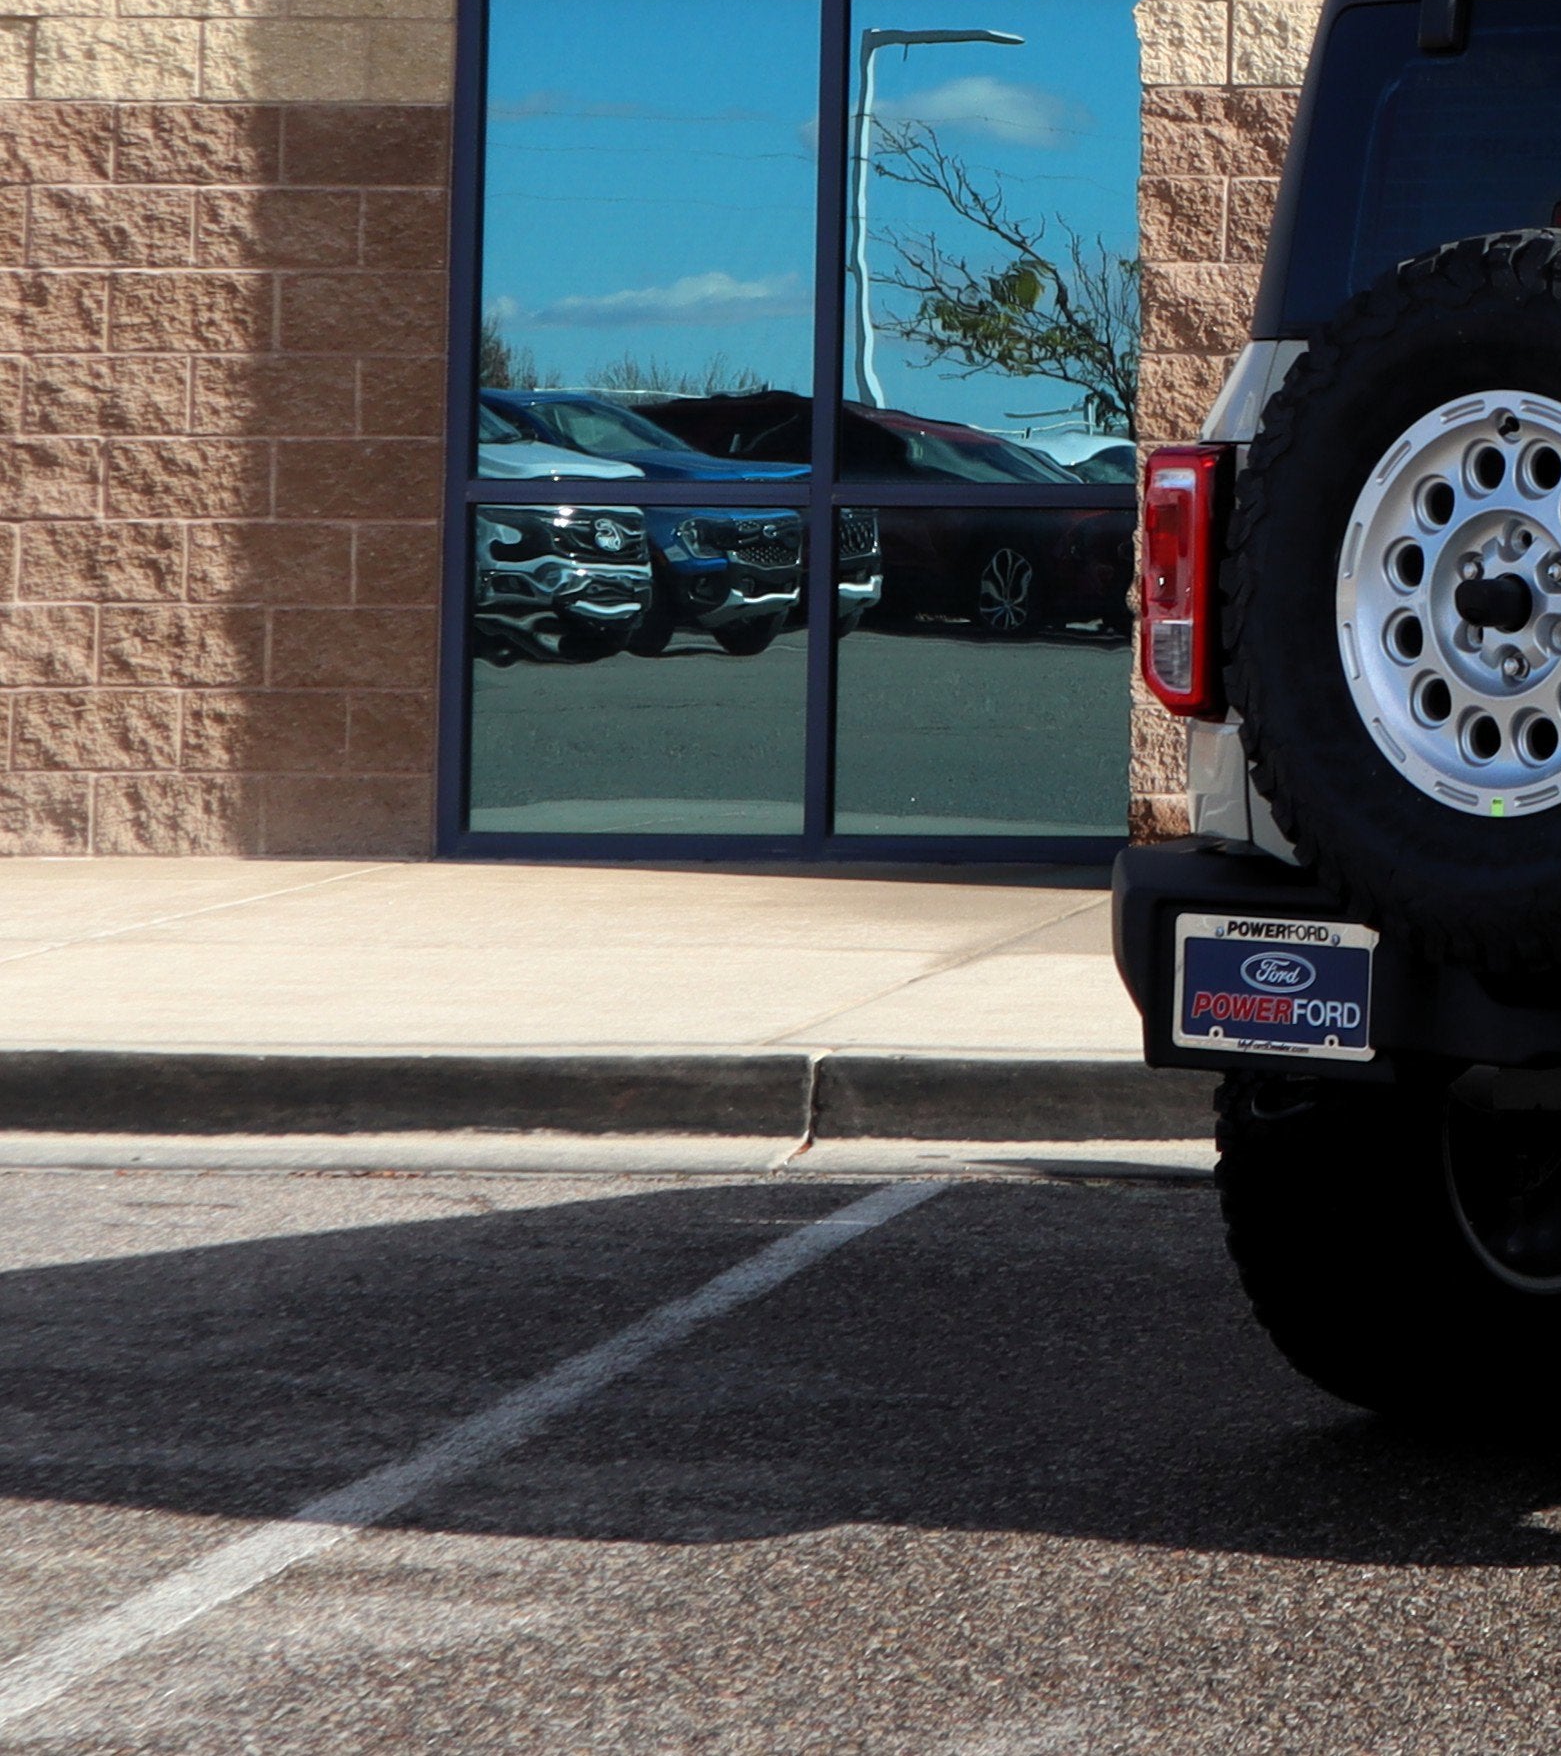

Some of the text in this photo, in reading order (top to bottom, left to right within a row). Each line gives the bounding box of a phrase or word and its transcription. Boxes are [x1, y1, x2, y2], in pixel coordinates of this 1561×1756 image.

[1227, 921, 1329, 941] POWERFORD
[1255, 958, 1301, 985] Ford
[1191, 991, 1361, 1028] POWERFORD
